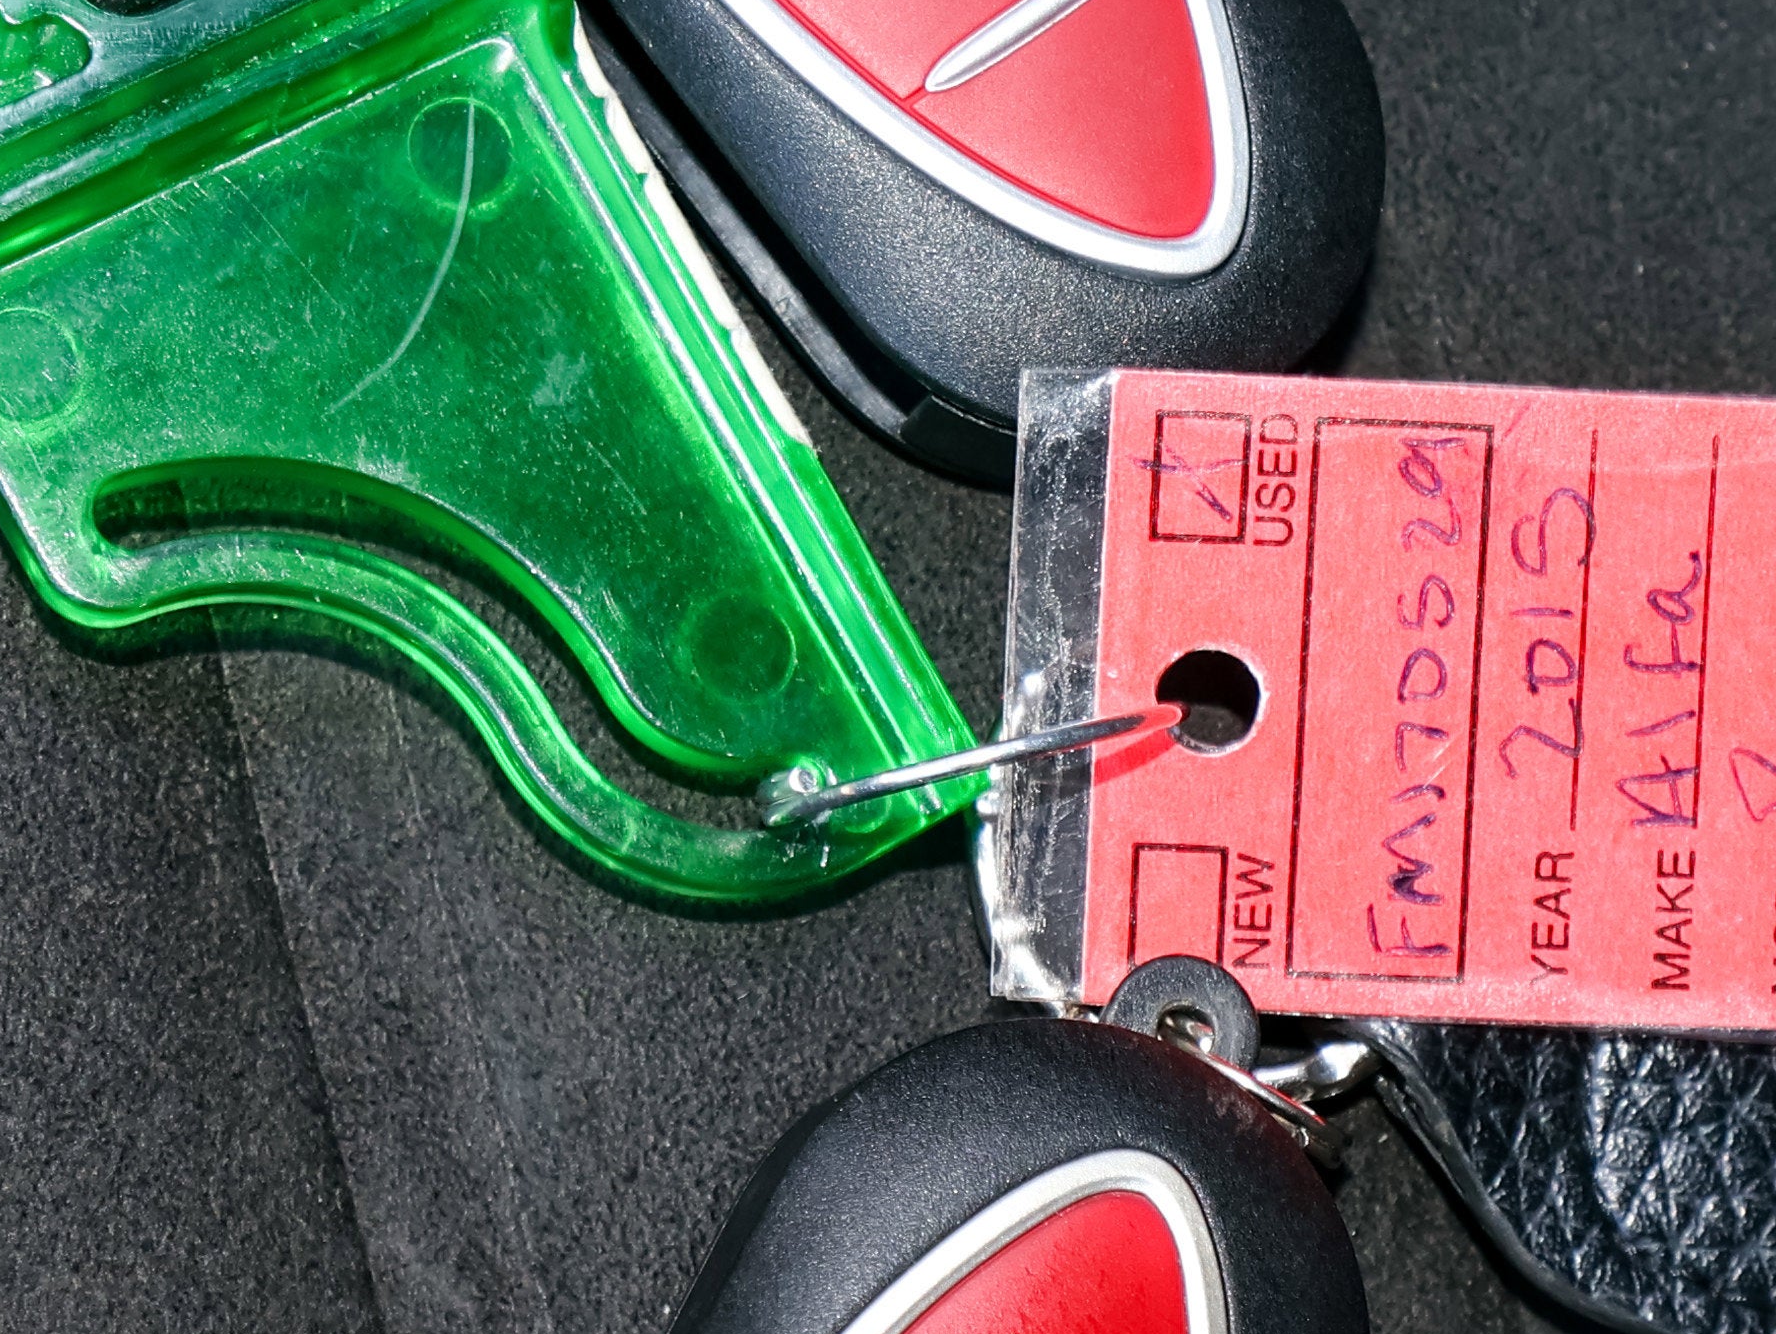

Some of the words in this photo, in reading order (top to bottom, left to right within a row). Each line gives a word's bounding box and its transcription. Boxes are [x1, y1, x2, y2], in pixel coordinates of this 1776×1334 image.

[1252, 414, 1300, 547] USED
[1500, 488, 1596, 779] 2015
[1233, 853, 1276, 969] NEW
[1530, 850, 1575, 988] YEAR
[1651, 849, 1697, 992] MAKE
